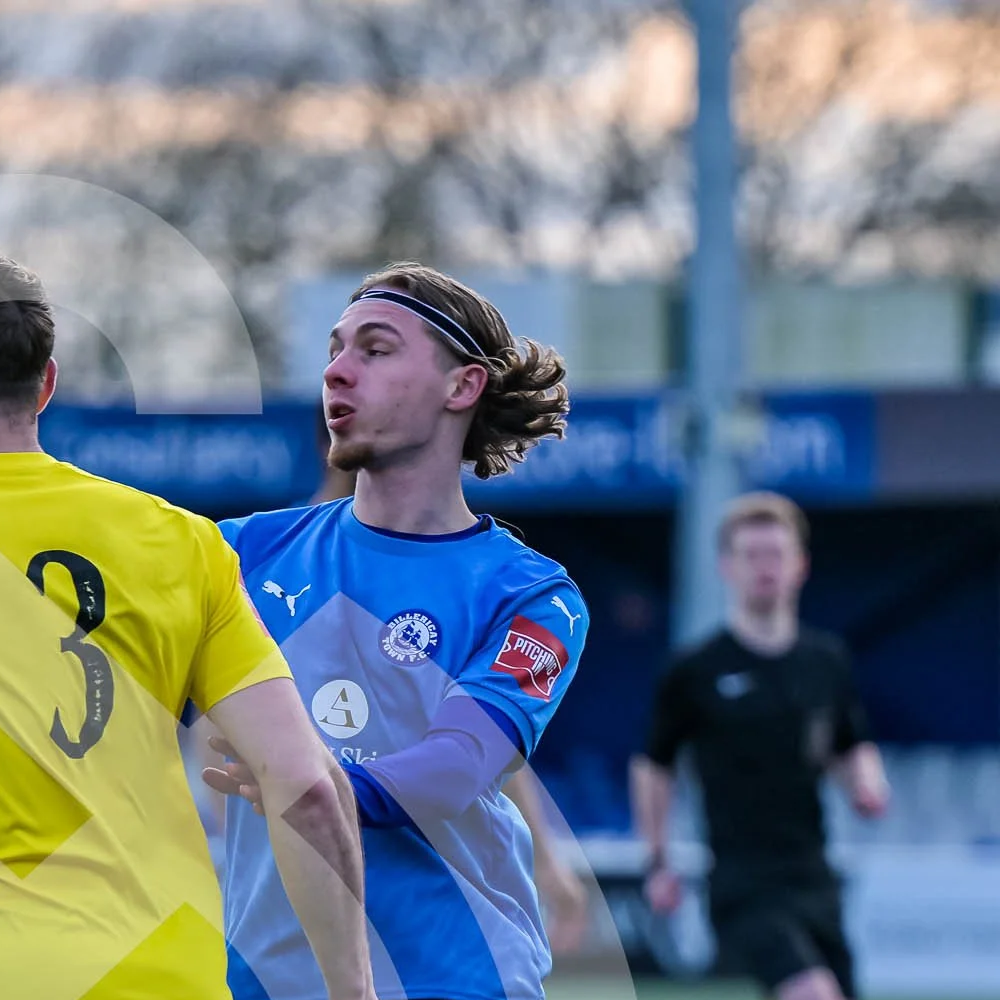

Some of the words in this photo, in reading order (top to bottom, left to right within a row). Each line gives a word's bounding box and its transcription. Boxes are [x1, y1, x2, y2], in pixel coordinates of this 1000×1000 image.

[387, 613, 438, 646] BILLERICAY
[26, 549, 114, 759] 3
[382, 636, 406, 661] TOWN
[513, 636, 557, 676] PITCHING
